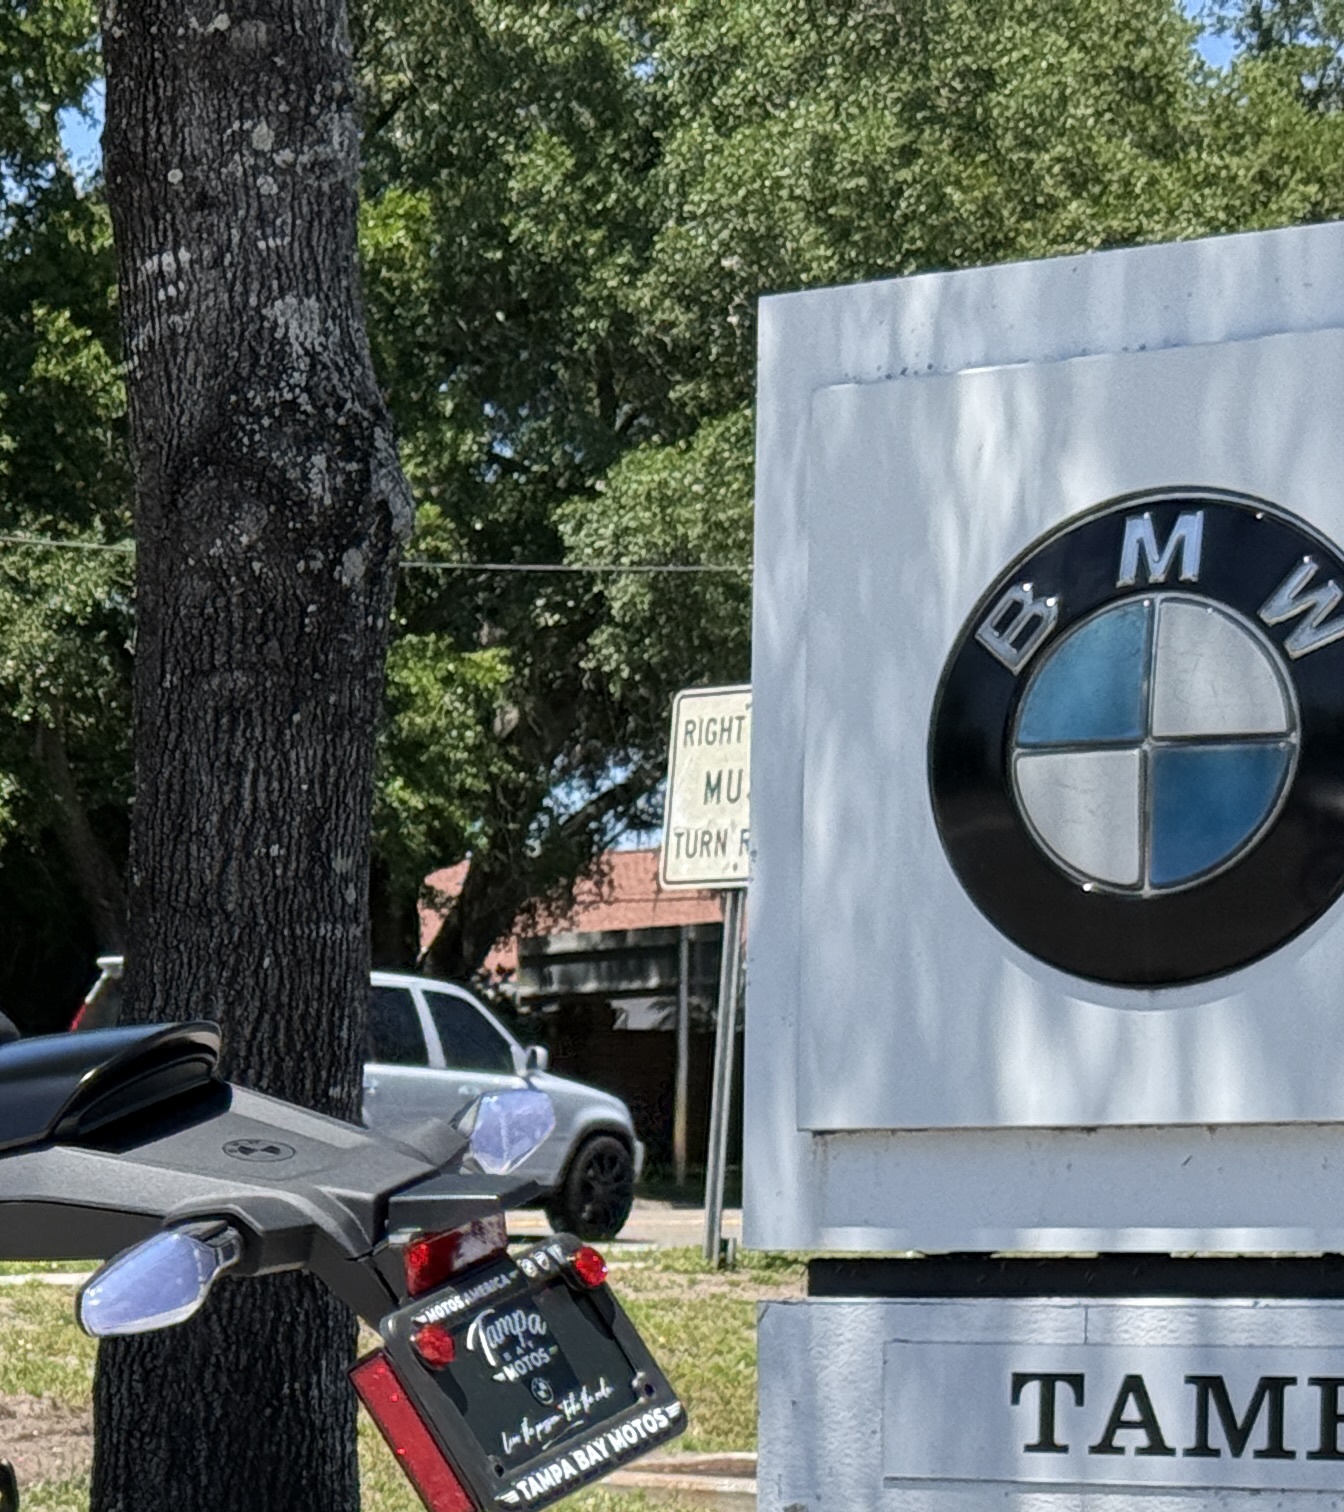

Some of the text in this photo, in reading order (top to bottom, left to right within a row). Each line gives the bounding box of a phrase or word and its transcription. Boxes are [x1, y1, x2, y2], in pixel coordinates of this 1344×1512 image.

[975, 509, 1344, 675] BMW
[683, 715, 746, 749] RIGHT
[703, 768, 750, 806] MU
[673, 827, 729, 860] TURN
[466, 1308, 547, 1367] Tampa
[502, 1347, 551, 1382] MOTOS
[515, 1458, 578, 1500] TAMPA
[572, 1436, 611, 1472] BAY
[607, 1406, 670, 1453] MOTOS
